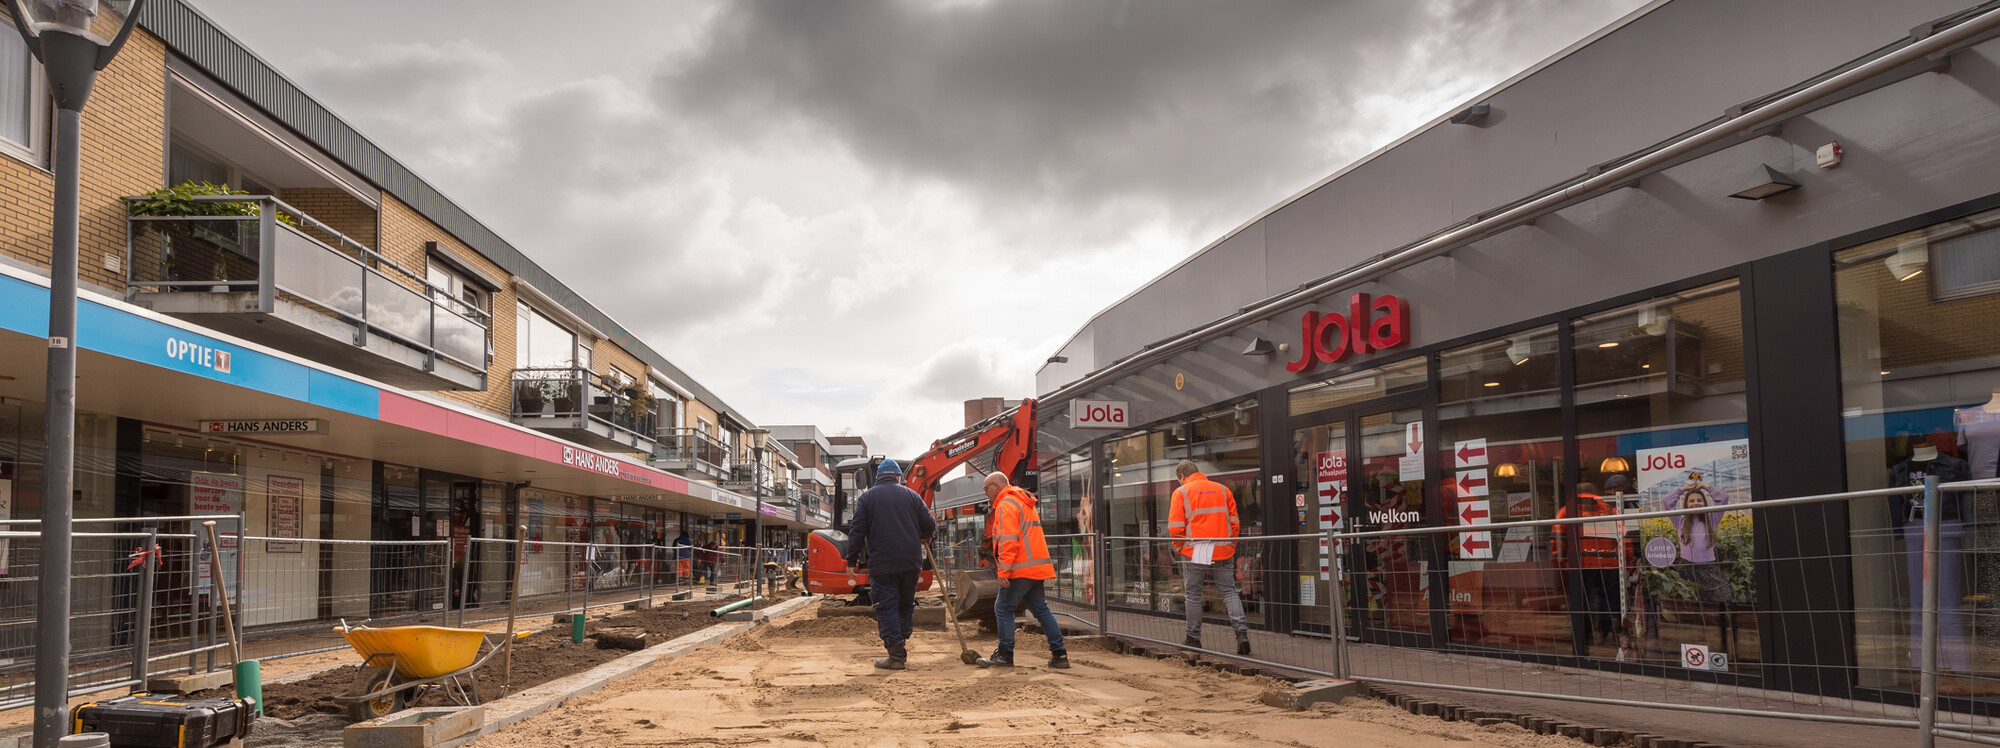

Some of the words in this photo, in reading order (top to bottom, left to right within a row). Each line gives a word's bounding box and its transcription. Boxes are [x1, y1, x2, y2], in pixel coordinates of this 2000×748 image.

[1286, 292, 1411, 374] Jola
[166, 337, 212, 368] OPTIE
[1080, 404, 1124, 423] Jola
[228, 422, 259, 432] HANS
[263, 421, 309, 432] ANDERS
[575, 449, 594, 470] HANS
[595, 455, 619, 476] ANDERS
[1319, 455, 1342, 470] Jola
[1641, 452, 1686, 471] Jola
[194, 485, 226, 496] hoorzorg
[211, 495, 220, 503] de
[194, 502, 214, 511] beste
[215, 503, 231, 513] prijs
[1511, 505, 1531, 513] Afhale
[1369, 508, 1420, 524] Welkom
[1423, 588, 1471, 602] Alen
